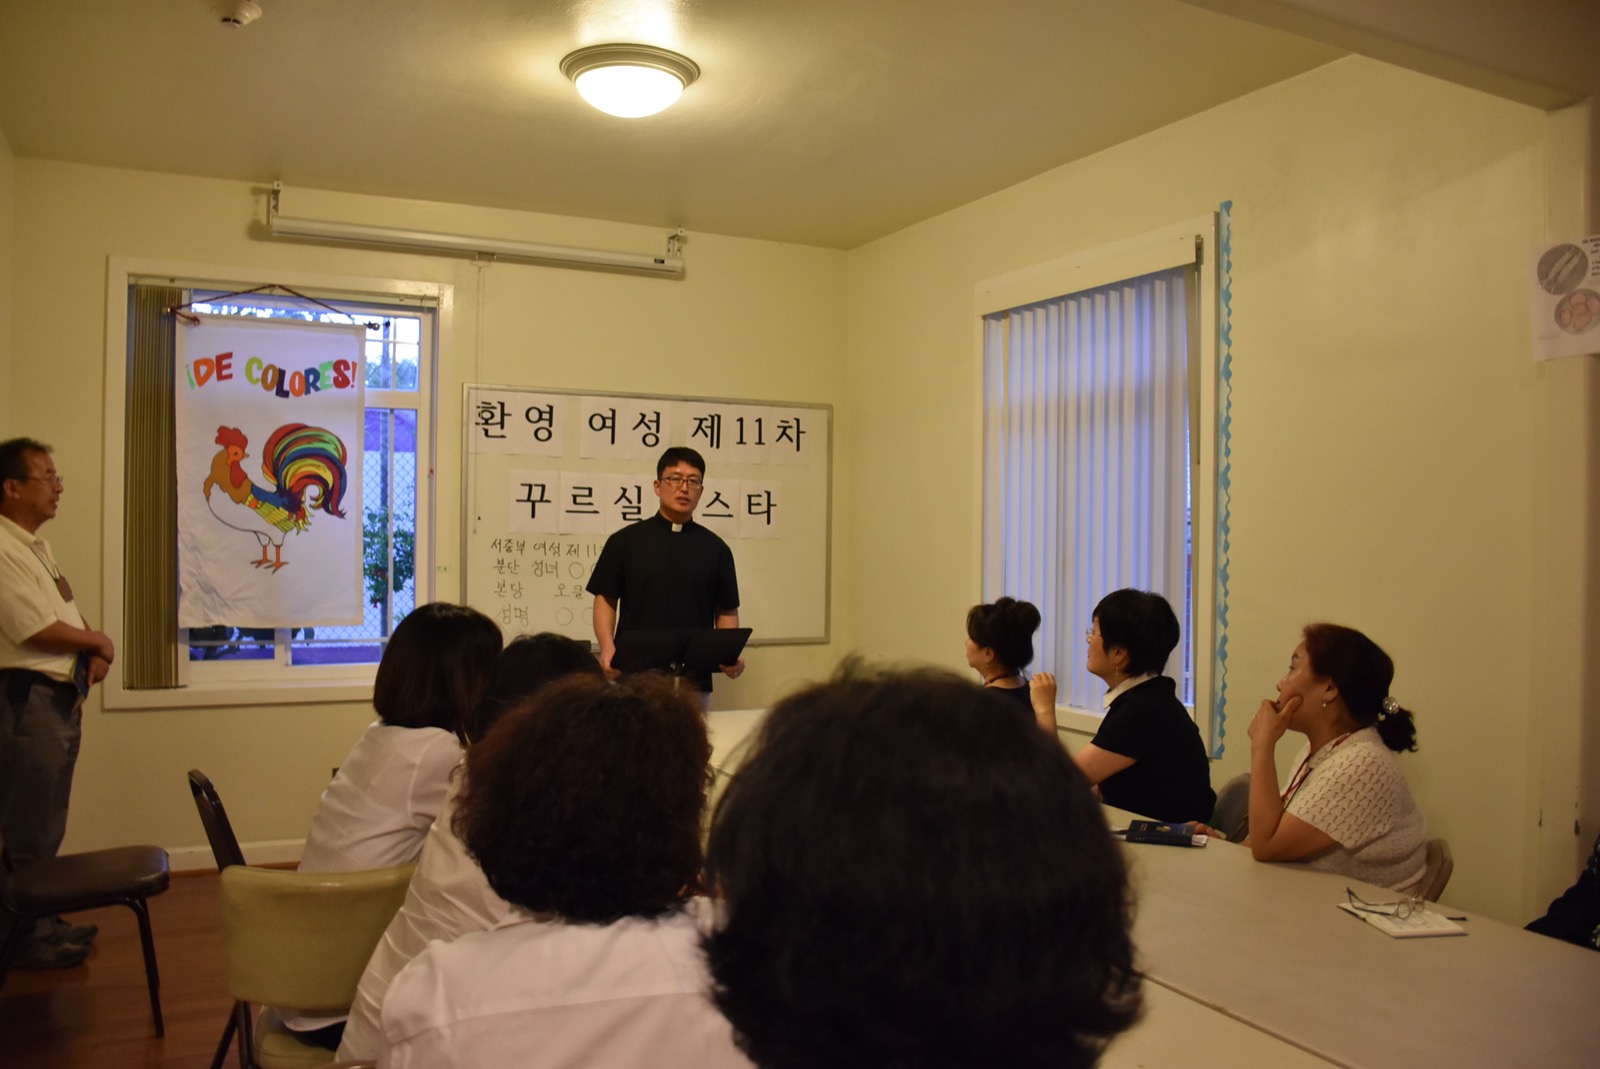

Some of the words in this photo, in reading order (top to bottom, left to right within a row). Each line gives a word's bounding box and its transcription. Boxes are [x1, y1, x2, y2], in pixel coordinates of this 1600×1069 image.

[245, 356, 358, 398] COLORES!
[475, 401, 554, 442] 환영
[588, 408, 661, 448] 여성
[691, 414, 806, 452] 제11차
[515, 483, 777, 525] 꾸르실스타
[533, 541, 560, 557] 여성
[532, 560, 559, 578] 성녀
[497, 604, 529, 627] 성명
